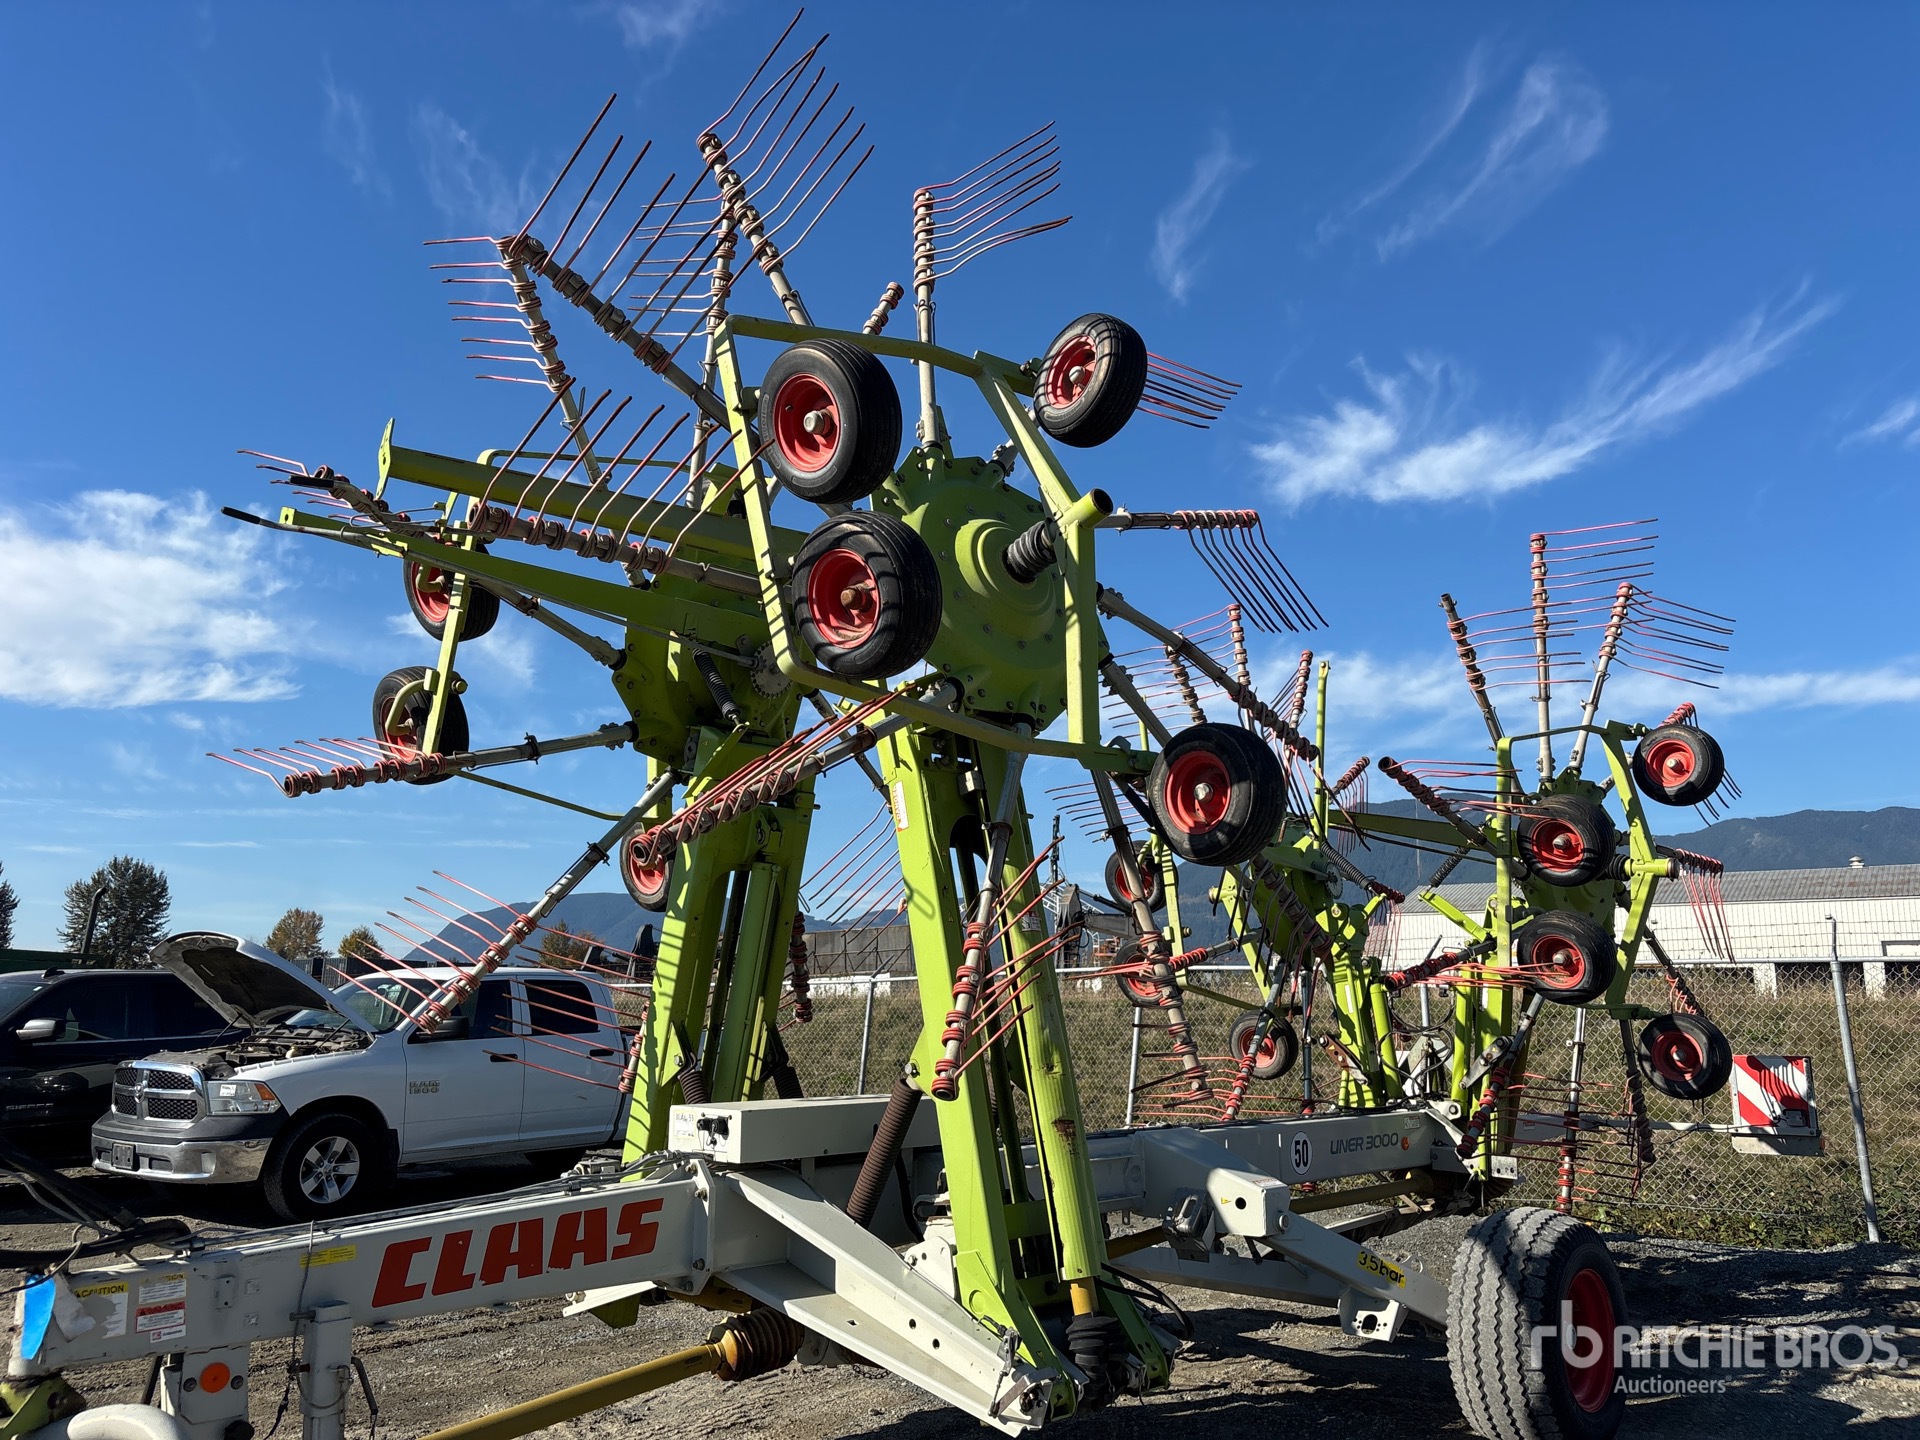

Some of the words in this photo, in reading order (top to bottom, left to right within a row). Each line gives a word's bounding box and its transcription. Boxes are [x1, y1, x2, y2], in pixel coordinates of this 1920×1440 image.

[1294, 1140, 1309, 1168] 50
[1330, 1137, 1364, 1155] LINER
[1366, 1132, 1399, 1150] 3000
[371, 1197, 665, 1309] CLAAS
